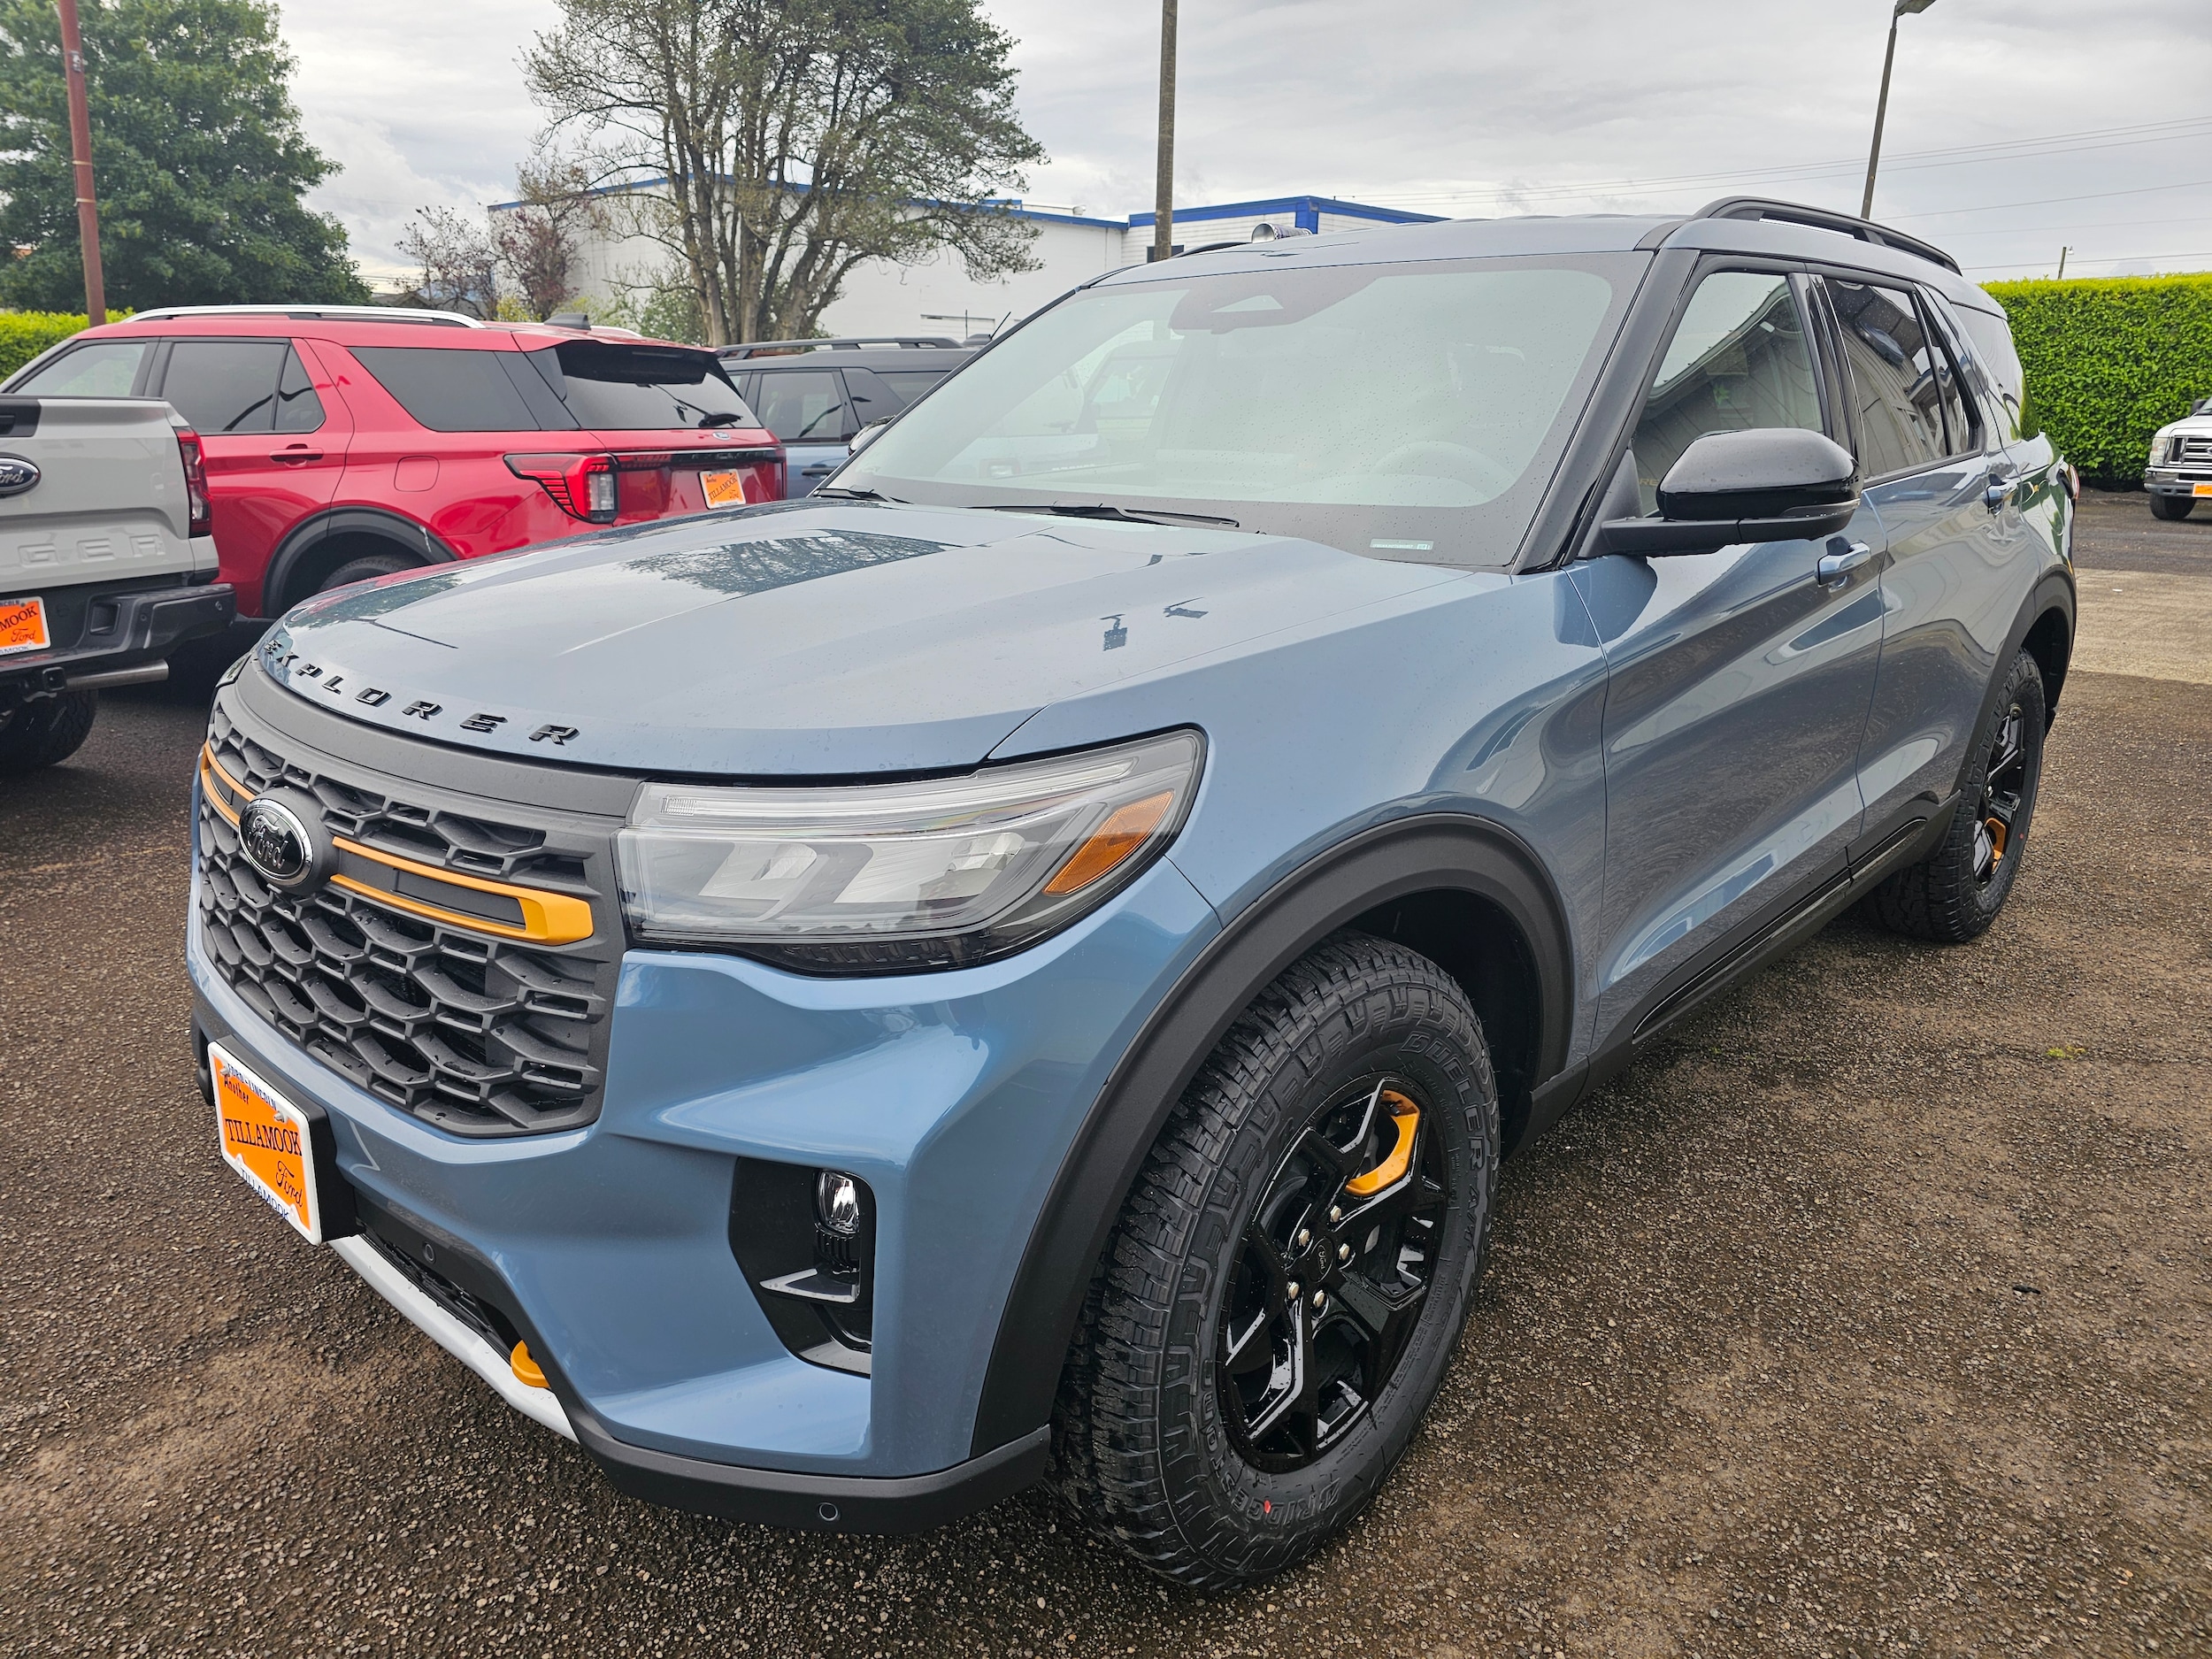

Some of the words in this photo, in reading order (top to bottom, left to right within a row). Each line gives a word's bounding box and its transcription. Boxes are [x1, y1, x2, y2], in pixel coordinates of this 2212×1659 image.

[0, 605, 39, 633] MOOK
[11, 627, 37, 642] Ford
[264, 640, 580, 746] EXPLORER
[248, 814, 288, 869] Ford
[1399, 1032, 1486, 1172] DUELER
[224, 1118, 303, 1156] TILLAMOOK
[276, 1160, 303, 1208] Ford
